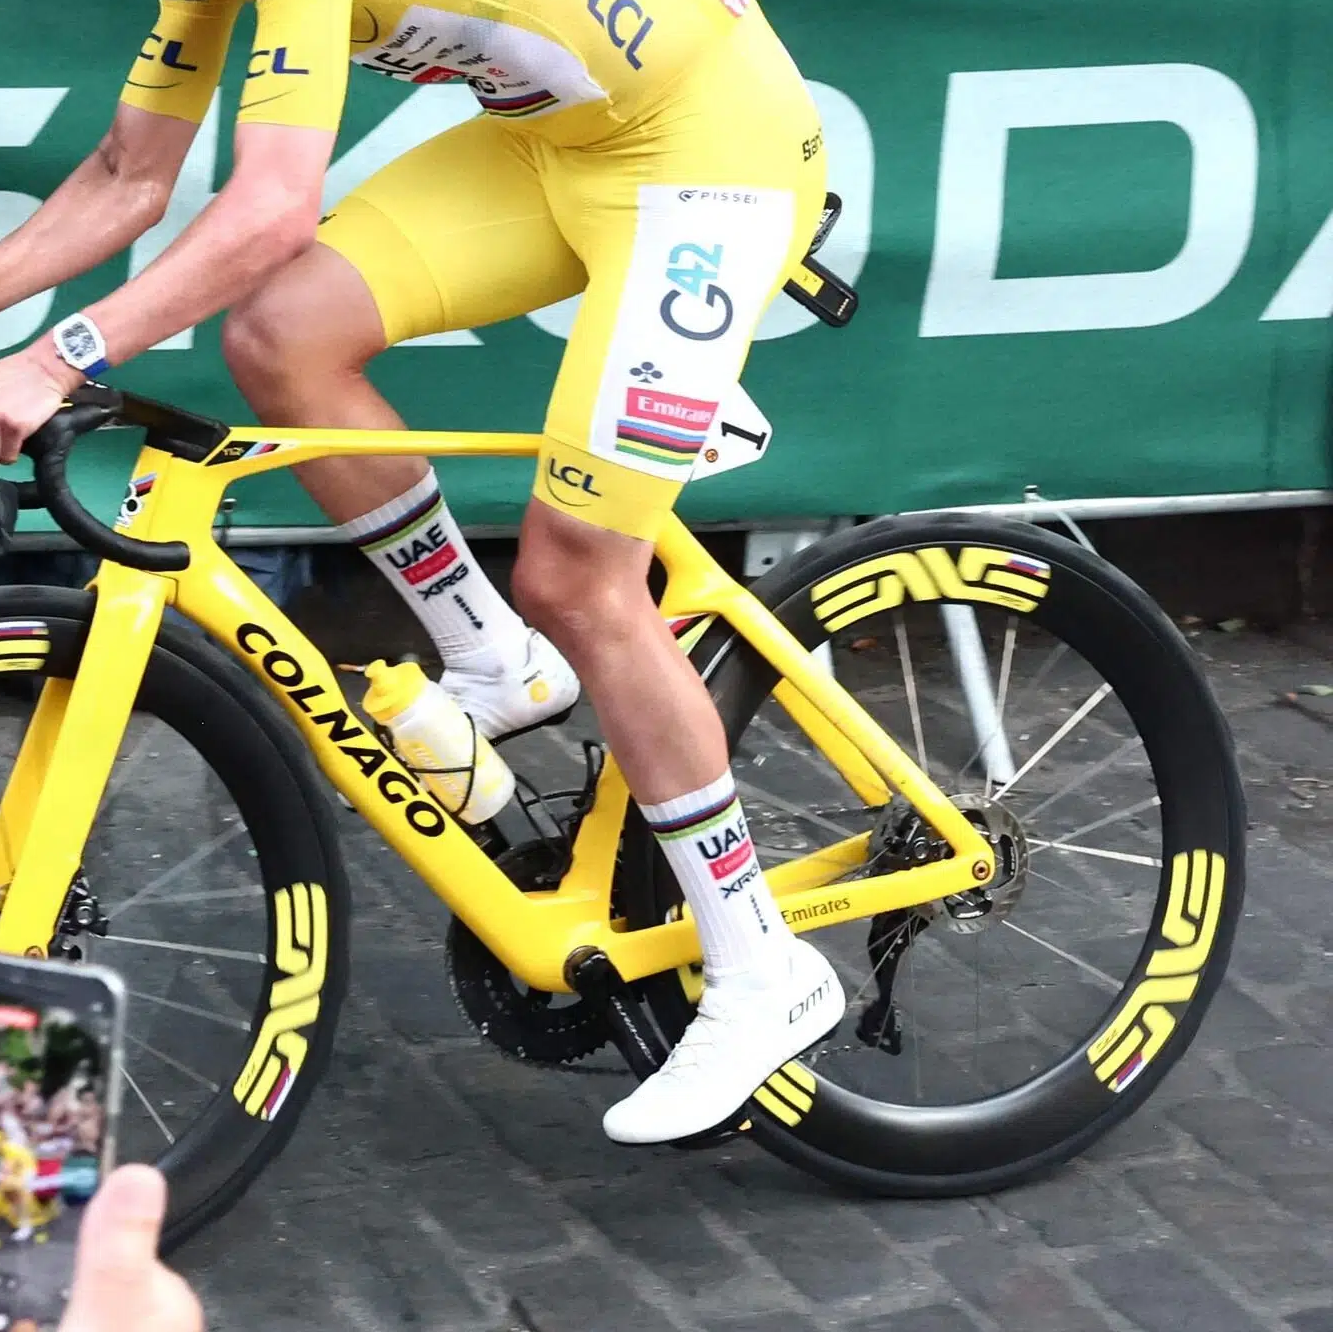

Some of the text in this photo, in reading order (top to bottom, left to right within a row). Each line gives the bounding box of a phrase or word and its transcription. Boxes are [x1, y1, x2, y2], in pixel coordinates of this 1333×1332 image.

[137, 33, 198, 72] CL
[245, 46, 310, 79] CL
[700, 192, 758, 205] PISSEI
[659, 242, 734, 342] G42
[636, 395, 715, 423] Emirates
[721, 421, 767, 451] 1
[549, 458, 602, 497] LCL
[385, 523, 448, 568] UAE
[417, 562, 470, 601] XRG
[811, 547, 1051, 633] ENVE
[236, 622, 446, 837] COLNAGO
[781, 897, 851, 925] Emirates
[1086, 849, 1226, 1093] ENVE
[233, 882, 327, 1122] ENVE
